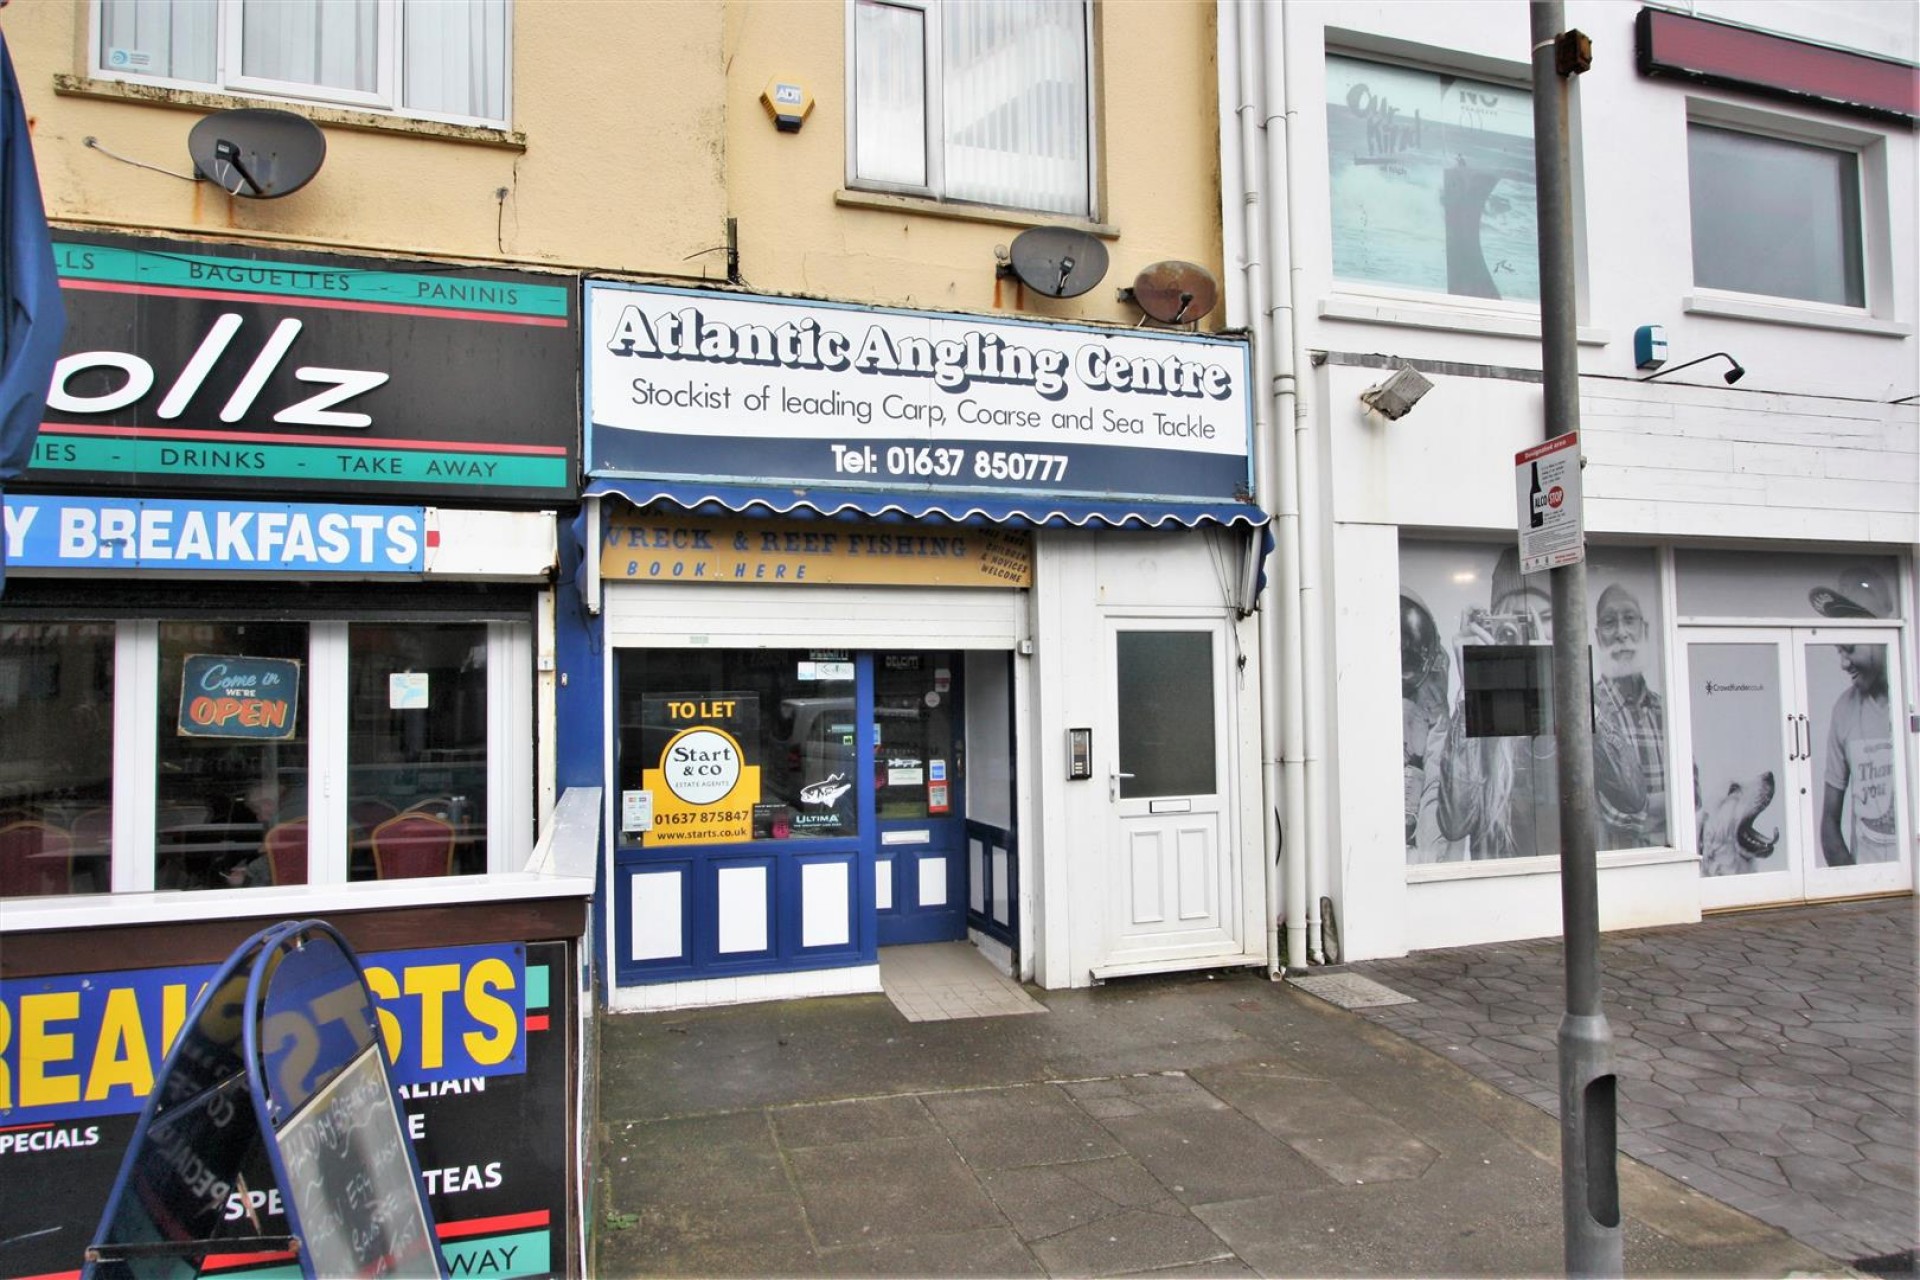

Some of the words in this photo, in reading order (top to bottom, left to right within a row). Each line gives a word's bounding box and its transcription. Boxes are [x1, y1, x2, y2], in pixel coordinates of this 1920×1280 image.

[57, 252, 95, 270] LS
[189, 261, 351, 292] BAGUETTES
[417, 281, 519, 305] PANINIS
[607, 304, 851, 372] Atlantic
[855, 324, 1068, 400] Angling
[1075, 344, 1232, 400] Centre
[632, 378, 731, 409] Stockist
[744, 385, 770, 411] of
[782, 387, 872, 424] leading
[883, 394, 946, 427] Carp,
[957, 399, 1041, 428] Coarse
[1051, 407, 1094, 432] and
[1102, 409, 1144, 434] Sea
[1152, 412, 1216, 439] Tackle
[161, 448, 266, 469] DRINKS
[337, 455, 404, 475] TAKE
[425, 459, 499, 478] AWAY
[832, 444, 877, 474] Tel:
[887, 446, 964, 476] 01637
[974, 451, 1069, 482] 850777
[59, 507, 418, 565] BREAKFASTS
[733, 530, 749, 551] &
[761, 531, 837, 555] REEF
[847, 532, 967, 557] FISHING
[627, 561, 706, 576] BOOK
[735, 563, 806, 580] HERE
[981, 564, 1023, 583] WELCOME
[202, 664, 257, 691] Come
[262, 671, 280, 686] in
[190, 696, 287, 728] OPEN
[668, 702, 696, 719] TO
[701, 701, 736, 718] LET
[674, 747, 731, 762] Start
[683, 765, 694, 776] &
[655, 812, 696, 825] 01637
[700, 810, 749, 824] 875847
[657, 827, 747, 840] www.starts.co.uk
[0, 1127, 98, 1155] PECIALS
[422, 1162, 502, 1196] TEAS
